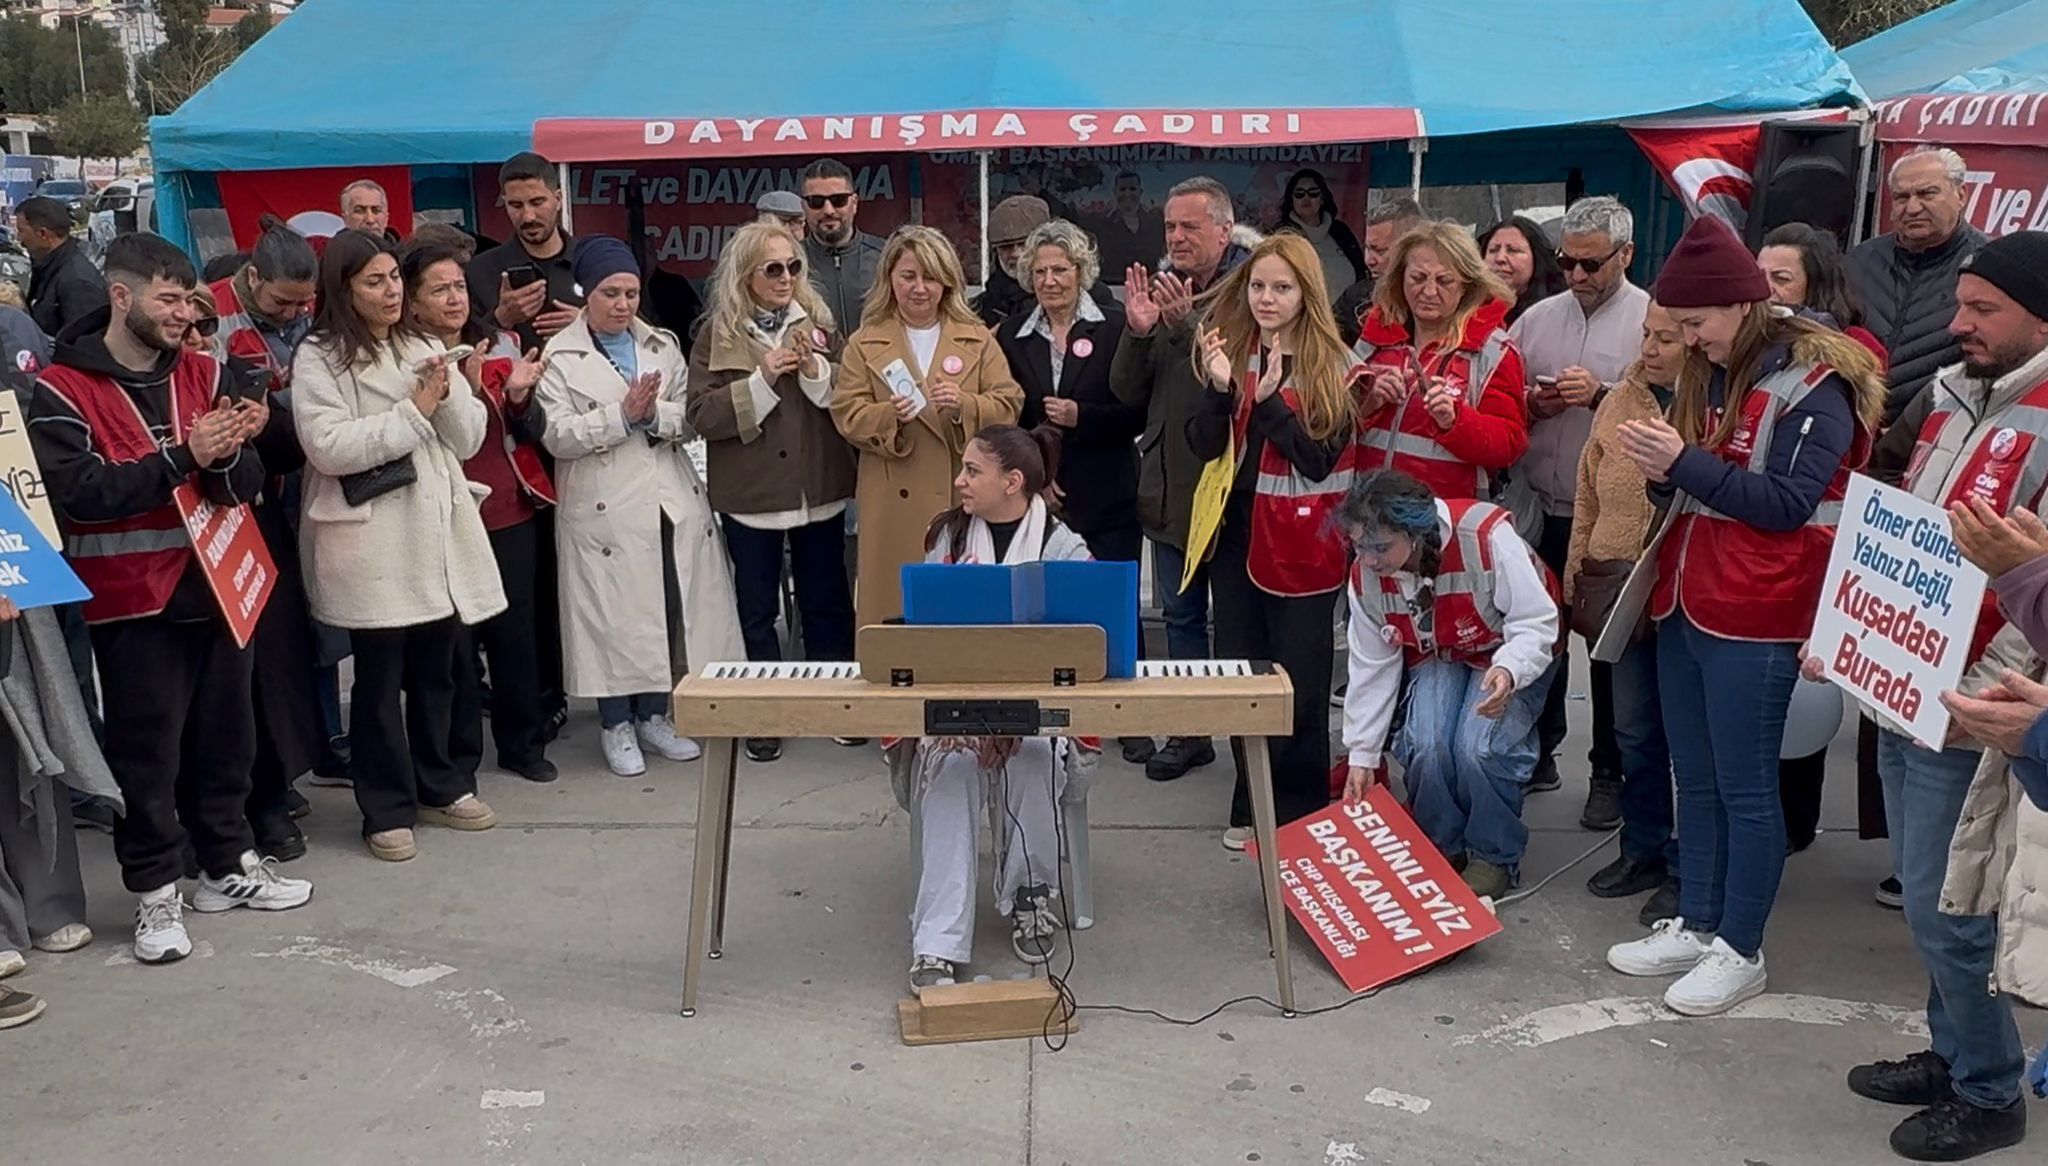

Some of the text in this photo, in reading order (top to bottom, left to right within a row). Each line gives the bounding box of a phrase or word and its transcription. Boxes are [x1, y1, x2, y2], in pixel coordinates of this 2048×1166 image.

[644, 112, 1299, 146] DAYANIŞMA ÇADIRI
[1917, 92, 2048, 134] ÇADIRI
[640, 175, 681, 206] ve
[1984, 187, 2032, 237] ve
[1862, 488, 1914, 540] Ömer
[1852, 532, 1953, 616] Yalnız Değil,
[1833, 569, 1950, 669] Kuşadası
[1833, 632, 1922, 723] Burada
[1296, 857, 1371, 942] CHP KUŞADASI
[1305, 819, 1435, 956] BAŞKANIM !
[1343, 800, 1472, 936] SENİNLEYİZ
[1292, 886, 1357, 960] BAŞKANLIĞI
